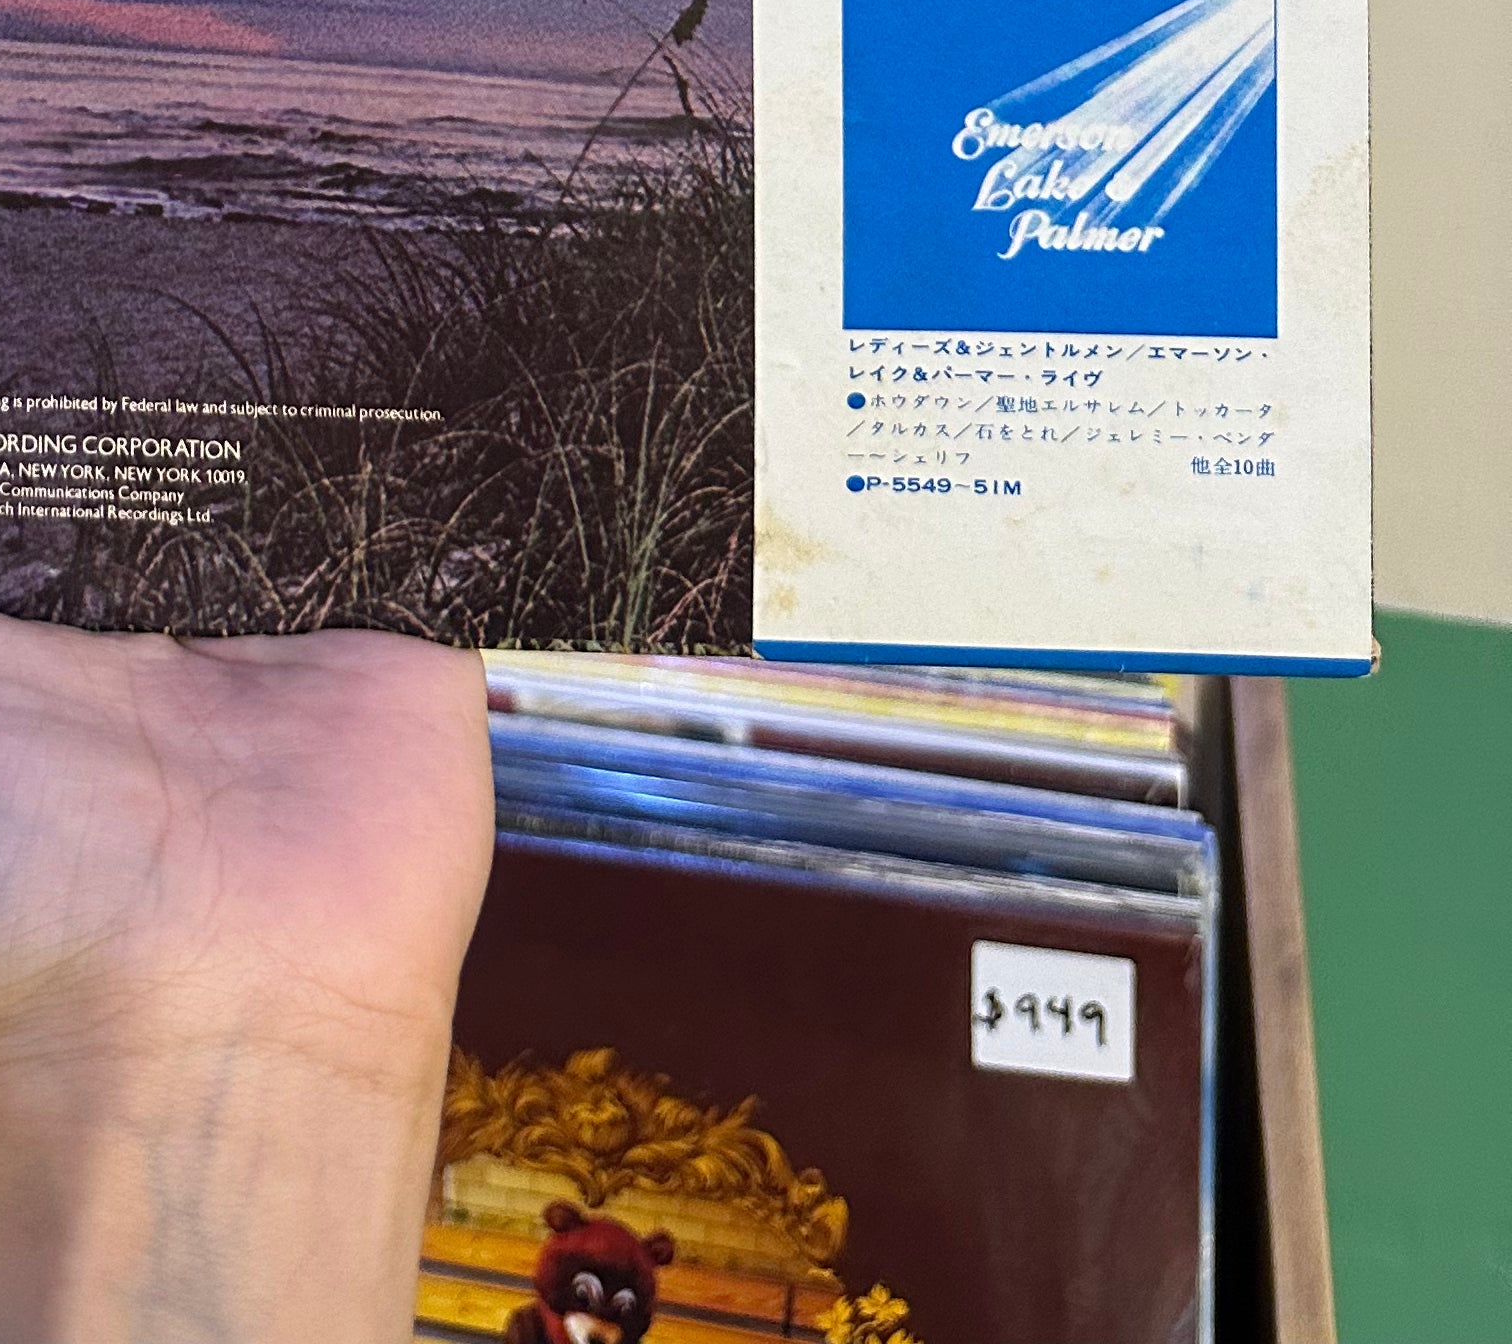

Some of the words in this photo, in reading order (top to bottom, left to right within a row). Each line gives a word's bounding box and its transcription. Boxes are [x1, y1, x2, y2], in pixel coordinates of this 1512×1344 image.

[952, 108, 1137, 159] Emerson
[997, 209, 1165, 259] Palmer
[82, 436, 240, 460] CORPORATION
[1191, 456, 1275, 476] 他全10曲
[19, 463, 57, 478] NEW
[61, 465, 110, 481] YORK,
[115, 466, 151, 482] NEW
[157, 468, 202, 483] YORK
[971, 986, 1107, 1047] $949
